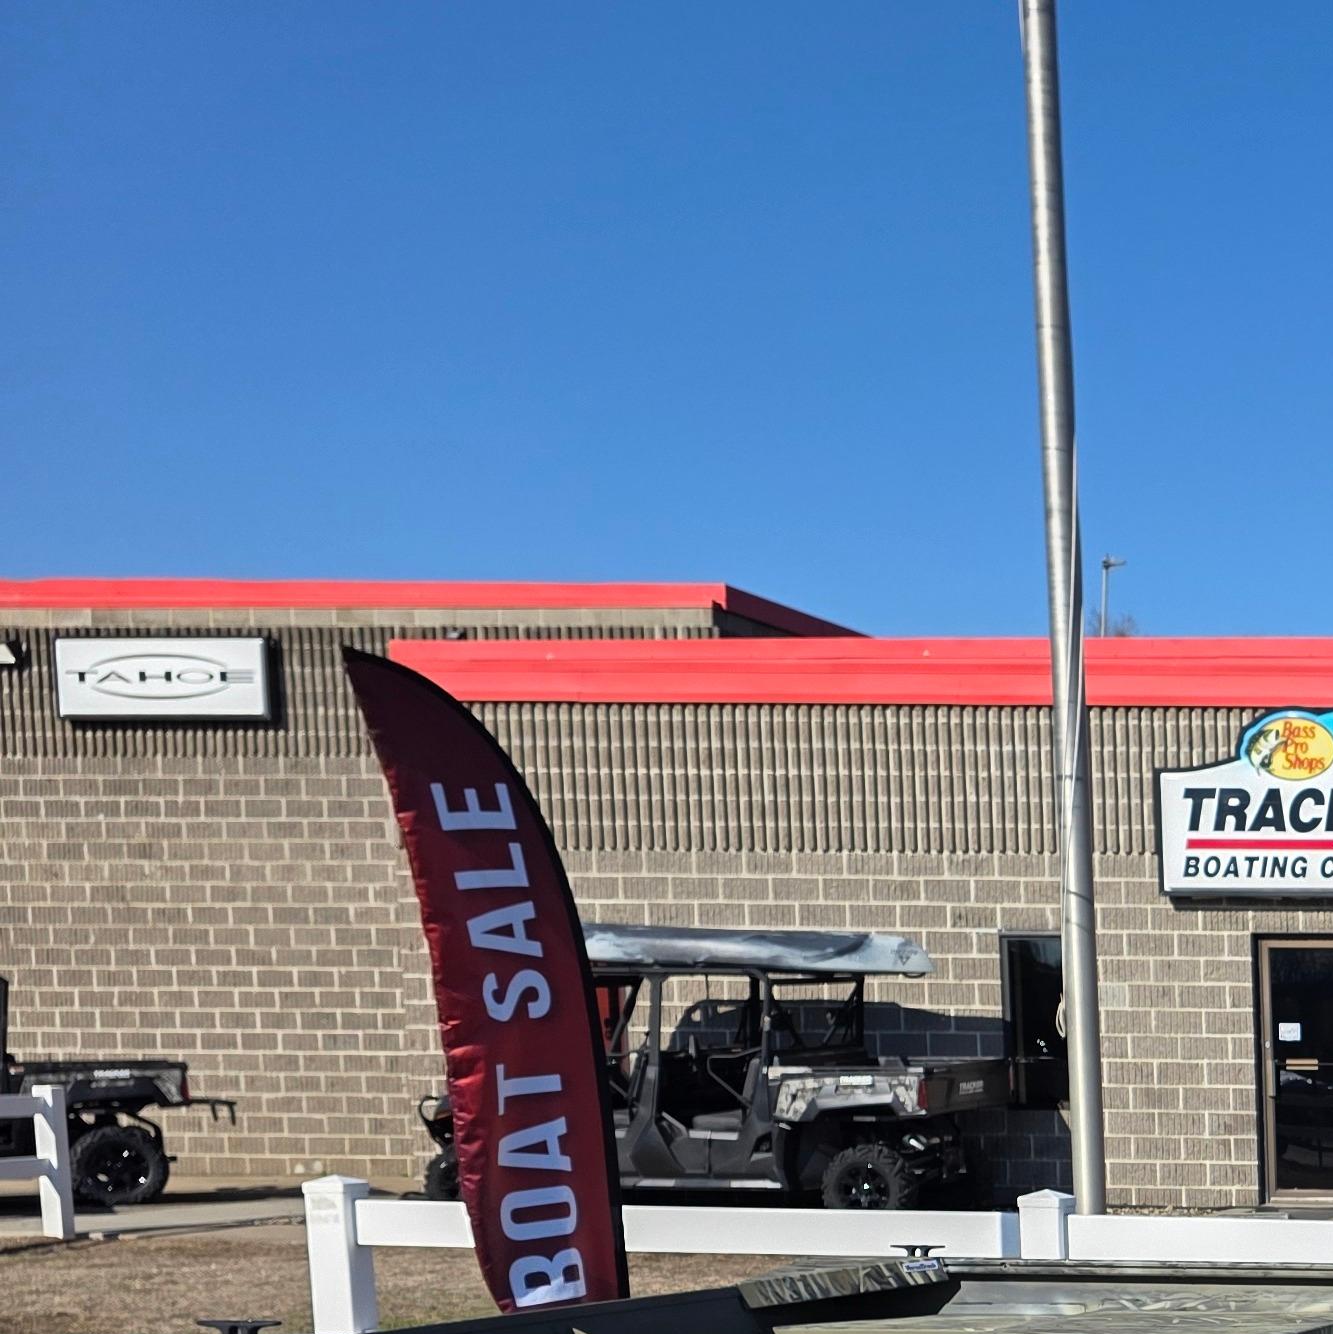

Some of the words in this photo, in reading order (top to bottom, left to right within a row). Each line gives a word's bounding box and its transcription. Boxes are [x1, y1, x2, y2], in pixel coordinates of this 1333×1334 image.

[65, 669, 255, 684] TAHOE
[1281, 721, 1316, 739] Bass
[1282, 738, 1309, 753] Pro
[1282, 753, 1325, 774] Shops
[1183, 856, 1308, 878] BOATING
[430, 783, 551, 1022] SALE
[496, 1064, 587, 1308] BOAT
